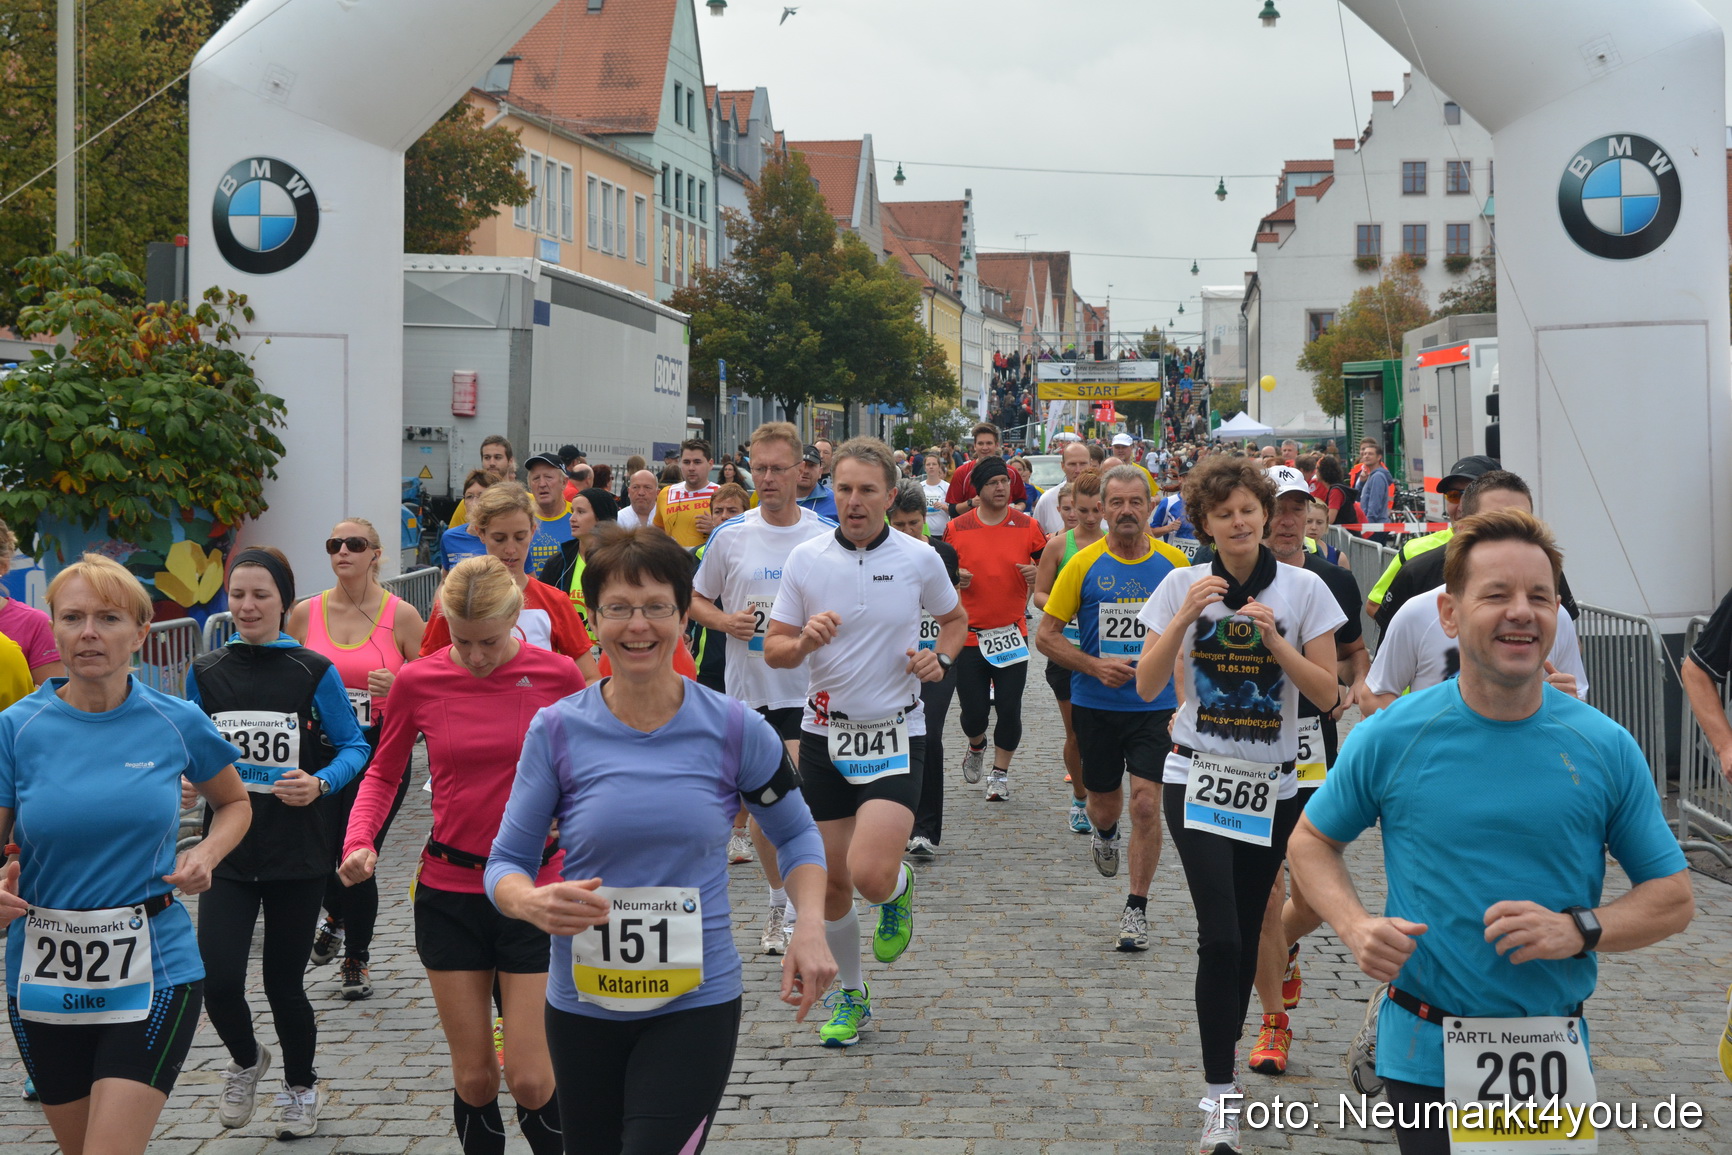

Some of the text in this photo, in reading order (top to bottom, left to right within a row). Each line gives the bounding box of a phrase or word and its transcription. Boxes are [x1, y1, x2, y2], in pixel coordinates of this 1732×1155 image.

[1568, 136, 1673, 180] BMW
[219, 159, 311, 199] BMW
[654, 354, 682, 397] BOCK
[1077, 385, 1120, 396] START
[666, 504, 690, 515] MAX
[764, 567, 782, 580] hei
[920, 620, 940, 639] 86
[1105, 617, 1150, 639] 226
[983, 632, 1021, 655] 2536
[1123, 643, 1141, 653] Karl
[996, 651, 1018, 662] Florian
[1229, 652, 1265, 665] Running
[1217, 663, 1260, 675] 18.05.2013
[240, 719, 284, 729] Neumarkt
[830, 719, 894, 730] PARTL Neumarkt
[1200, 713, 1280, 729] www.sv-amberg.de
[220, 730, 290, 763] 336
[837, 727, 899, 757] 2041
[849, 760, 889, 774] Michael
[1192, 760, 1267, 779] PARTL Neumarkt
[1195, 774, 1270, 812] 2568
[1213, 812, 1242, 829] Karin
[613, 899, 678, 911] Neumarkt
[27, 917, 125, 934] PARTL Neumarkt
[592, 917, 668, 964] 151
[34, 936, 137, 983] 2927
[598, 974, 669, 994] Katarina
[63, 993, 106, 1010] Silke
[1447, 1030, 1566, 1044] PARTL Neumarkt
[1476, 1050, 1568, 1102] 260
